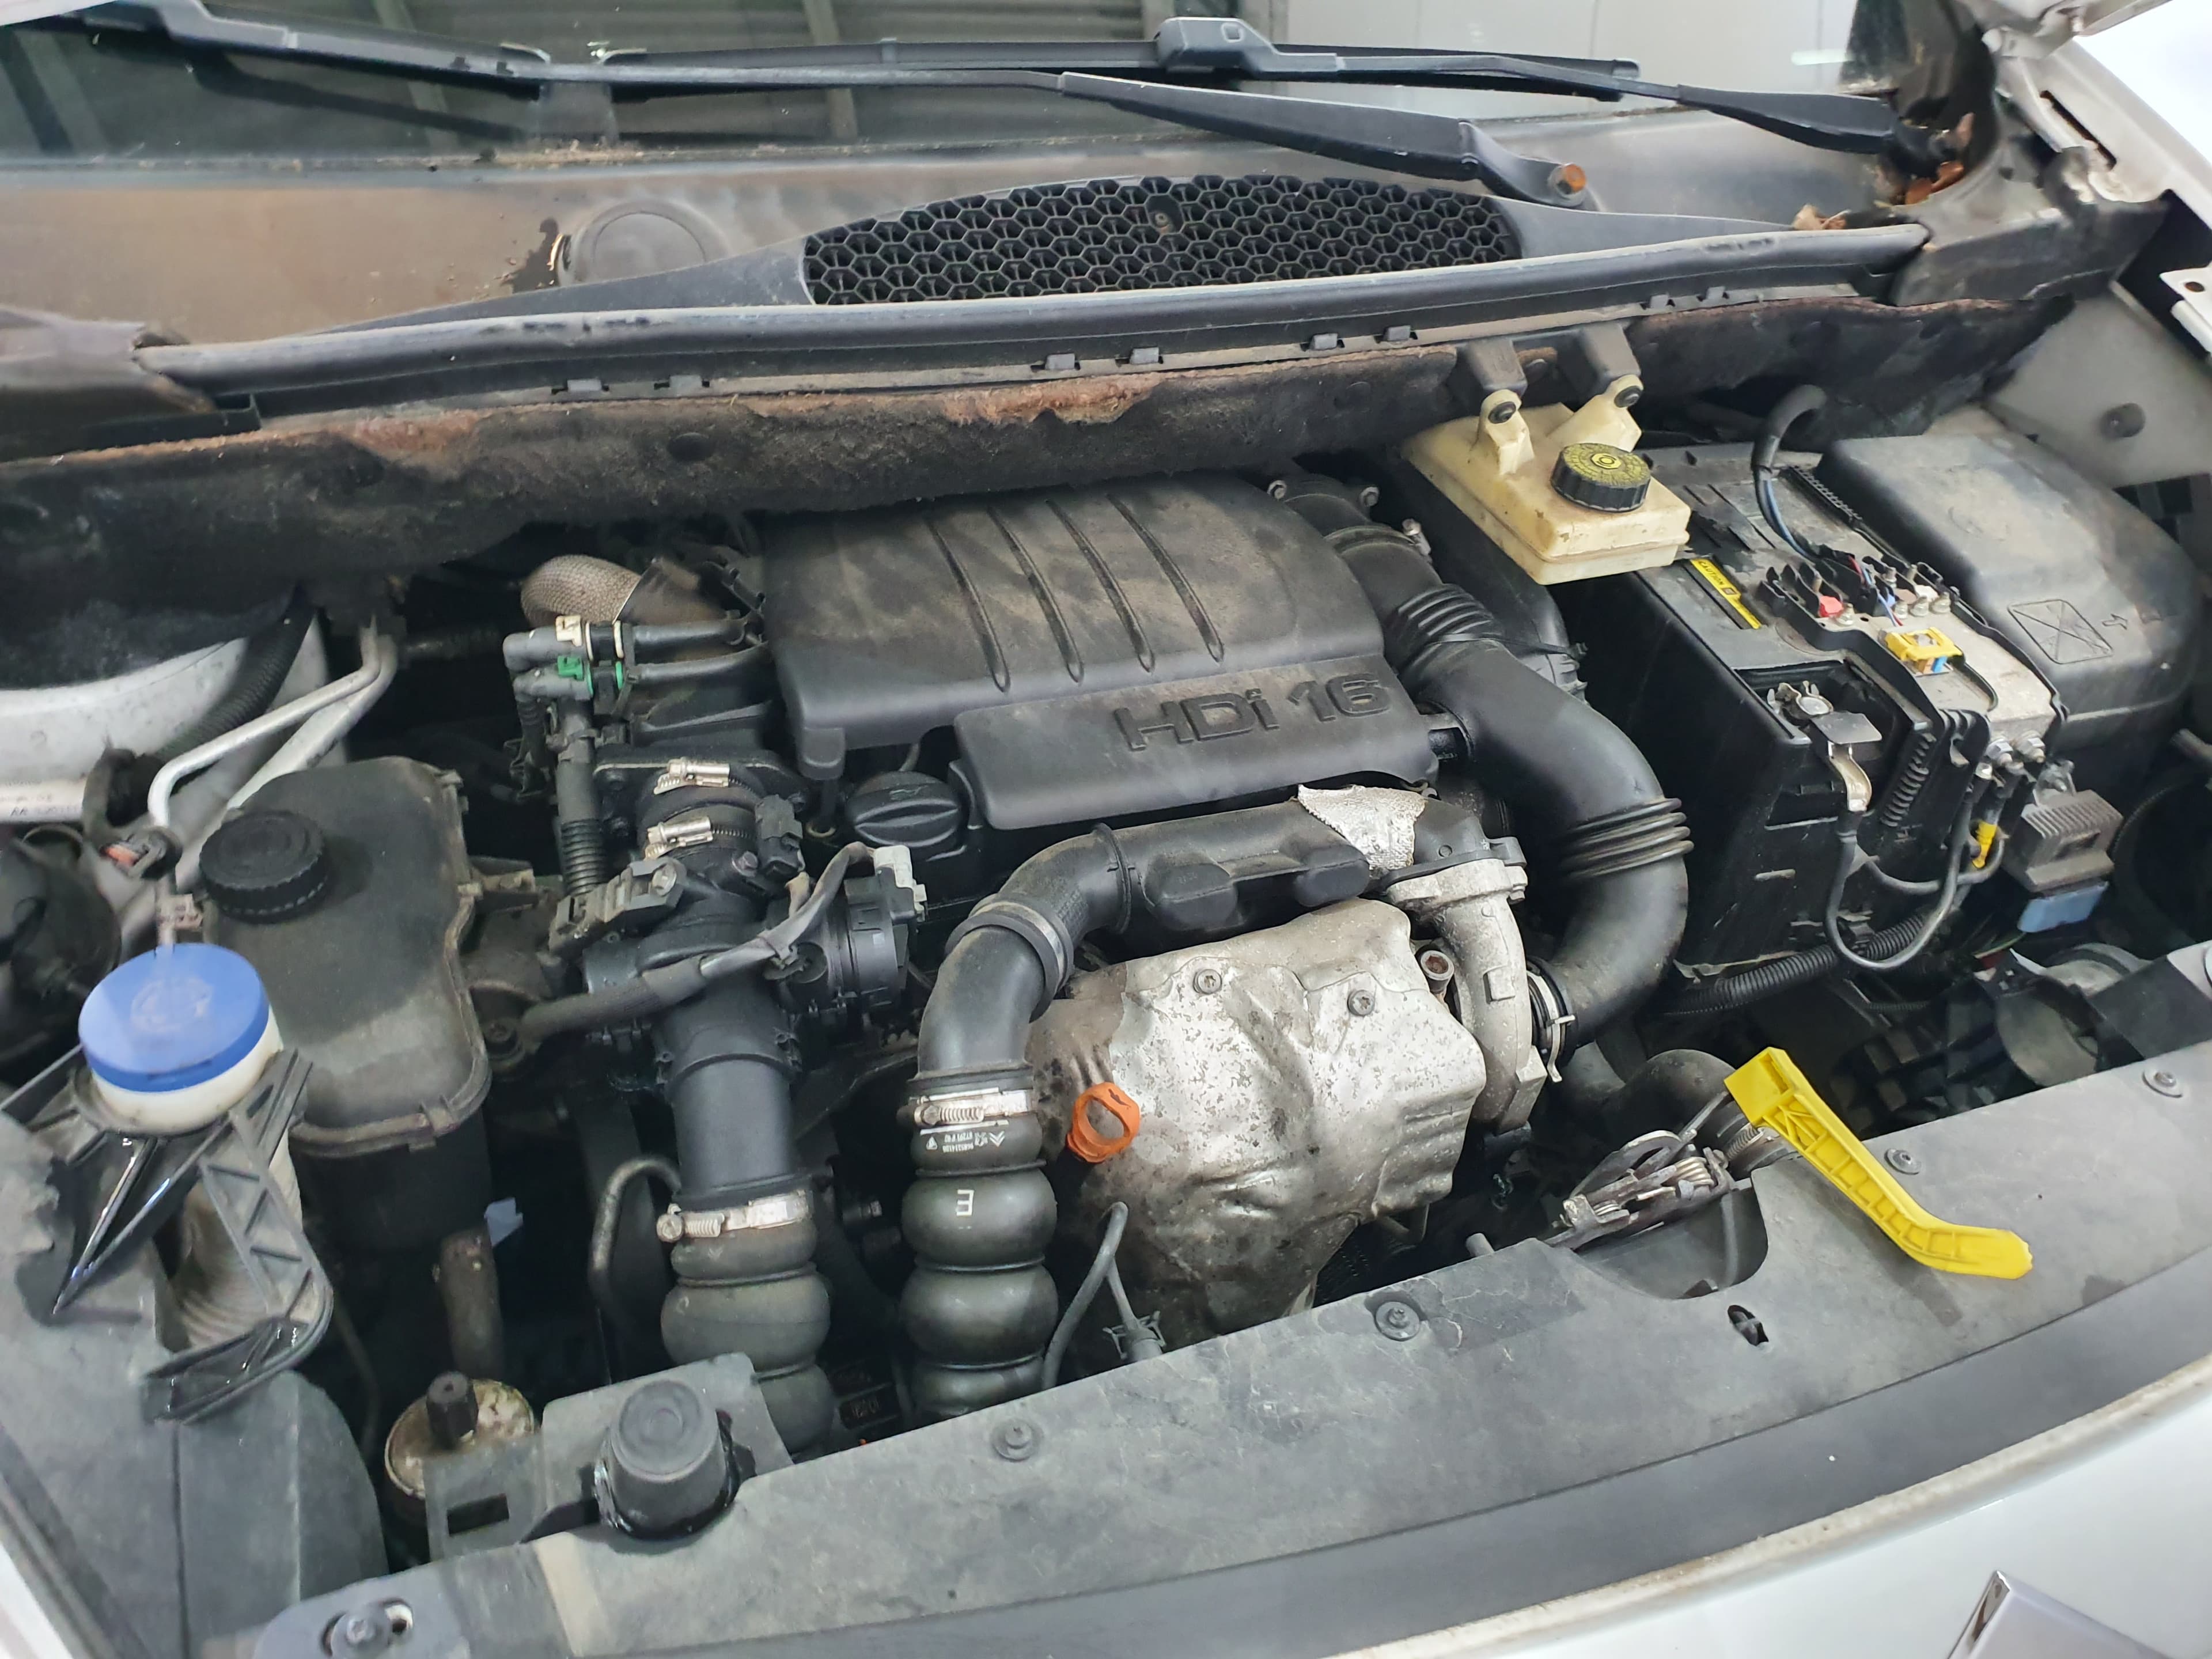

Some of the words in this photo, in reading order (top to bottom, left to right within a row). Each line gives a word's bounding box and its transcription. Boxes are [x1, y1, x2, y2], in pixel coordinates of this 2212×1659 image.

[1699, 560, 1724, 585] CAUTION
[1112, 688, 1280, 751] HDi
[1287, 672, 1391, 722] 16
